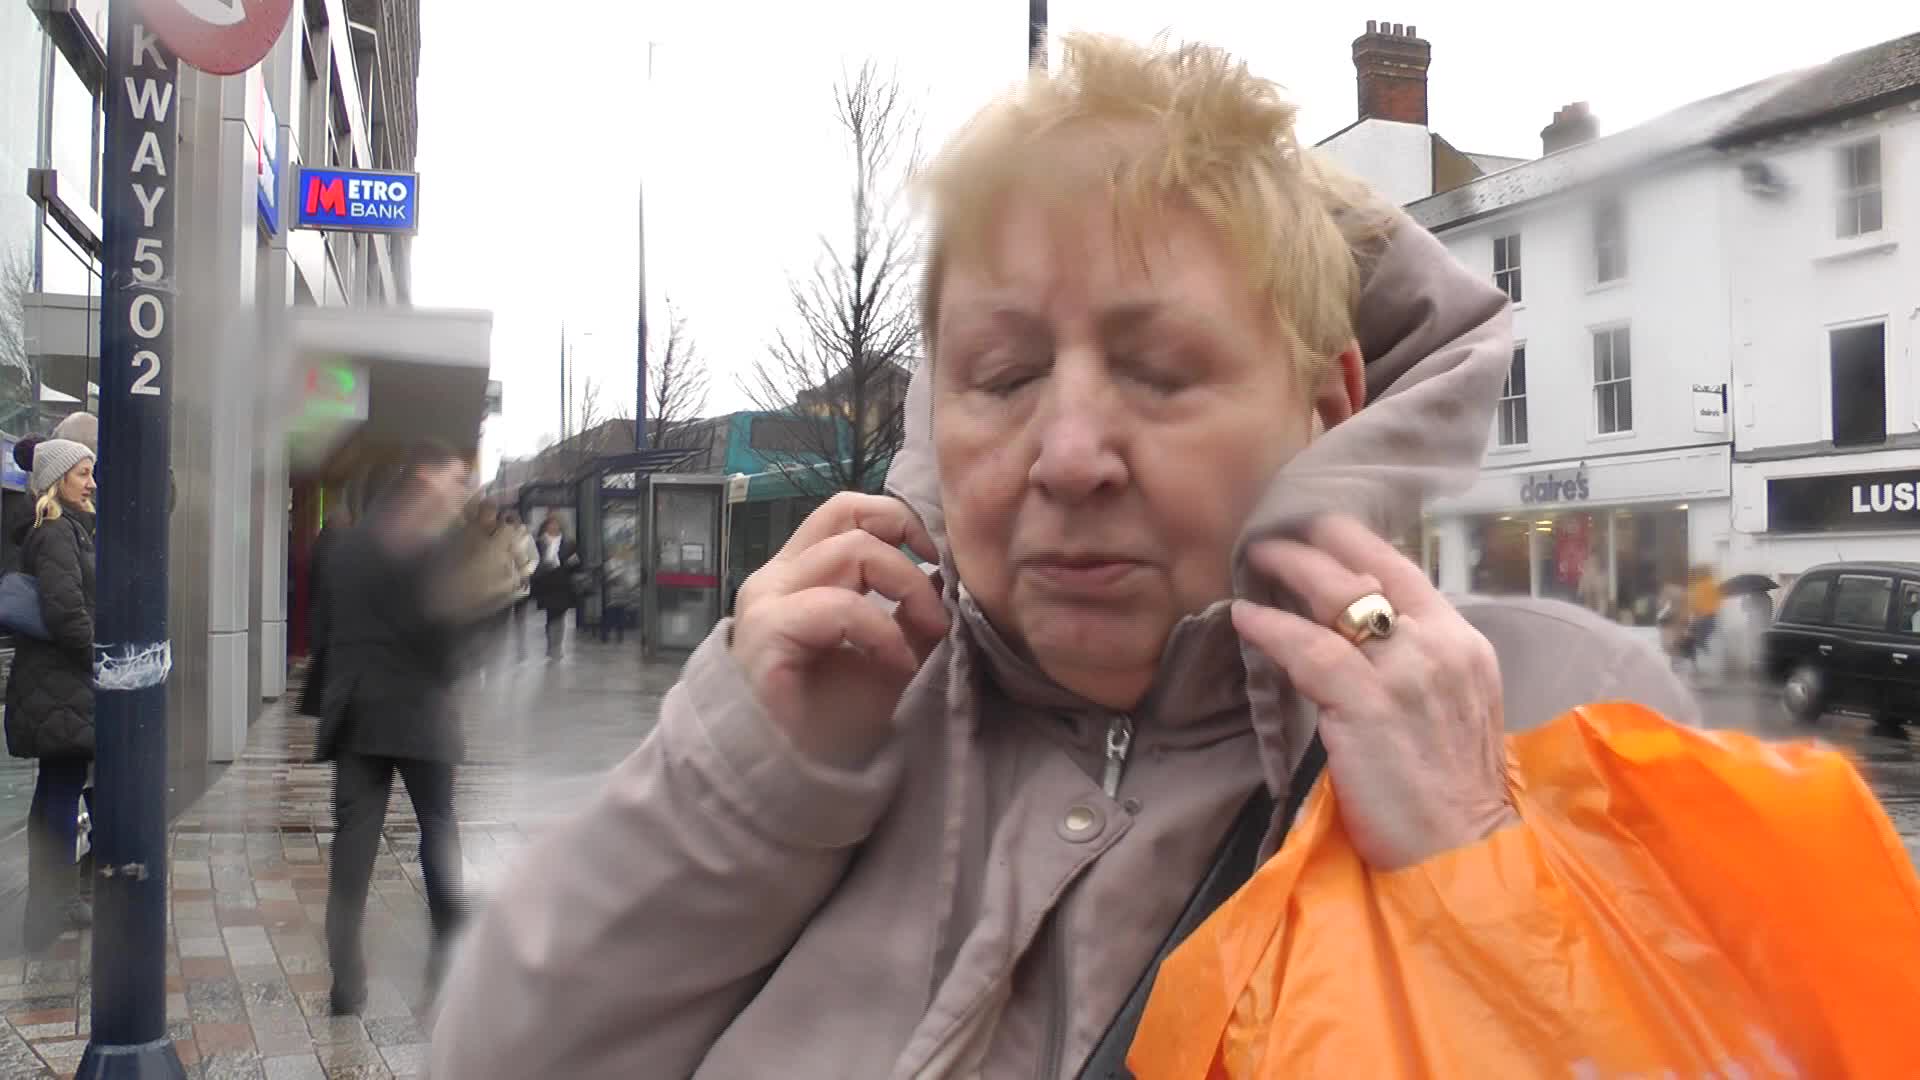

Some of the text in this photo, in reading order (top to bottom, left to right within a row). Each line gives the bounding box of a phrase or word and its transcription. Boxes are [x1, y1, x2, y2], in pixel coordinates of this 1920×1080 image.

[306, 175, 408, 216] METRO
[350, 202, 406, 219] BANK
[1521, 460, 1590, 504] claire's
[1852, 482, 1920, 513] LUS
